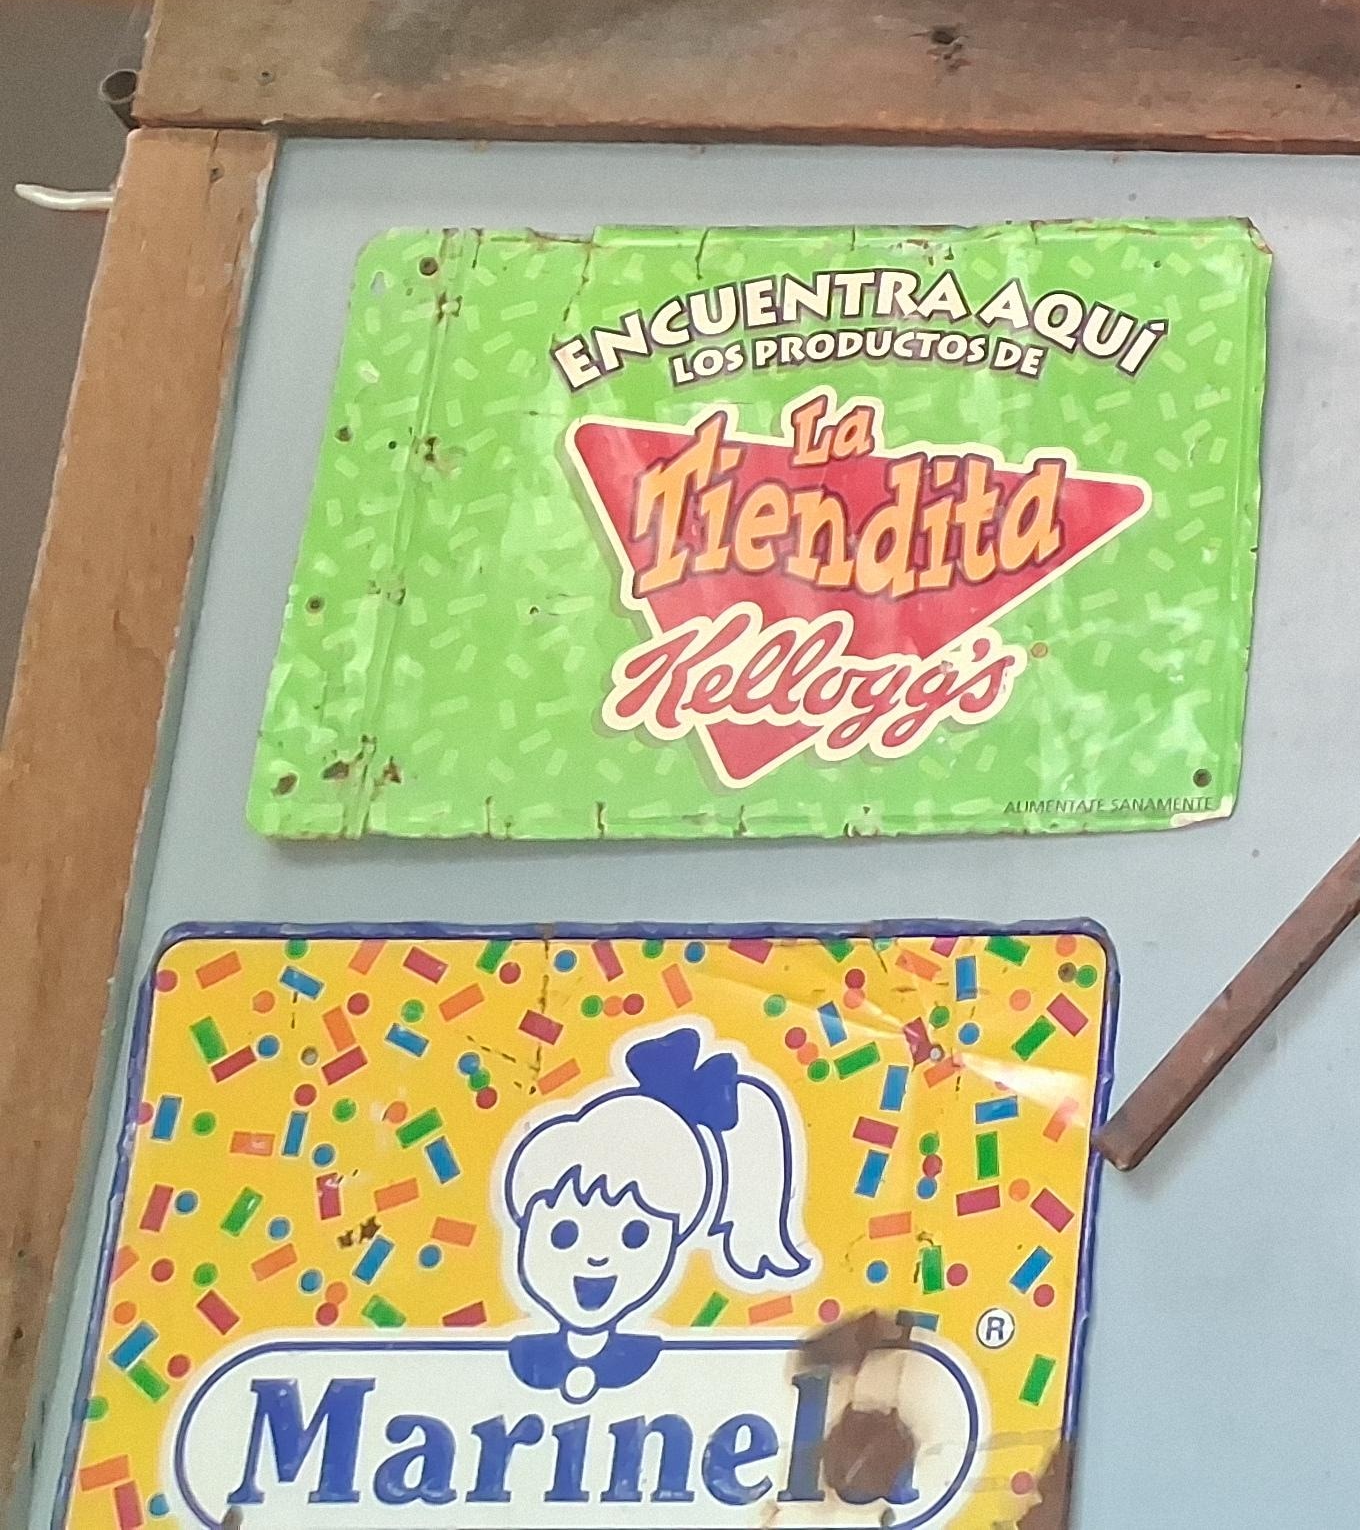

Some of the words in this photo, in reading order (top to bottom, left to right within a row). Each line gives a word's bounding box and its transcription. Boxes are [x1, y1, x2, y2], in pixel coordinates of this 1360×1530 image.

[551, 269, 971, 390] ENCUENTRA
[980, 278, 1168, 375] AQUÍ
[671, 341, 746, 386] LOS
[753, 330, 987, 369] PRODUCTOS
[991, 339, 1044, 378] DE
[791, 394, 875, 467] La
[632, 410, 1067, 601] Tiendita
[615, 612, 1015, 751] Kellogg's
[1111, 796, 1216, 812] SANAMENTE
